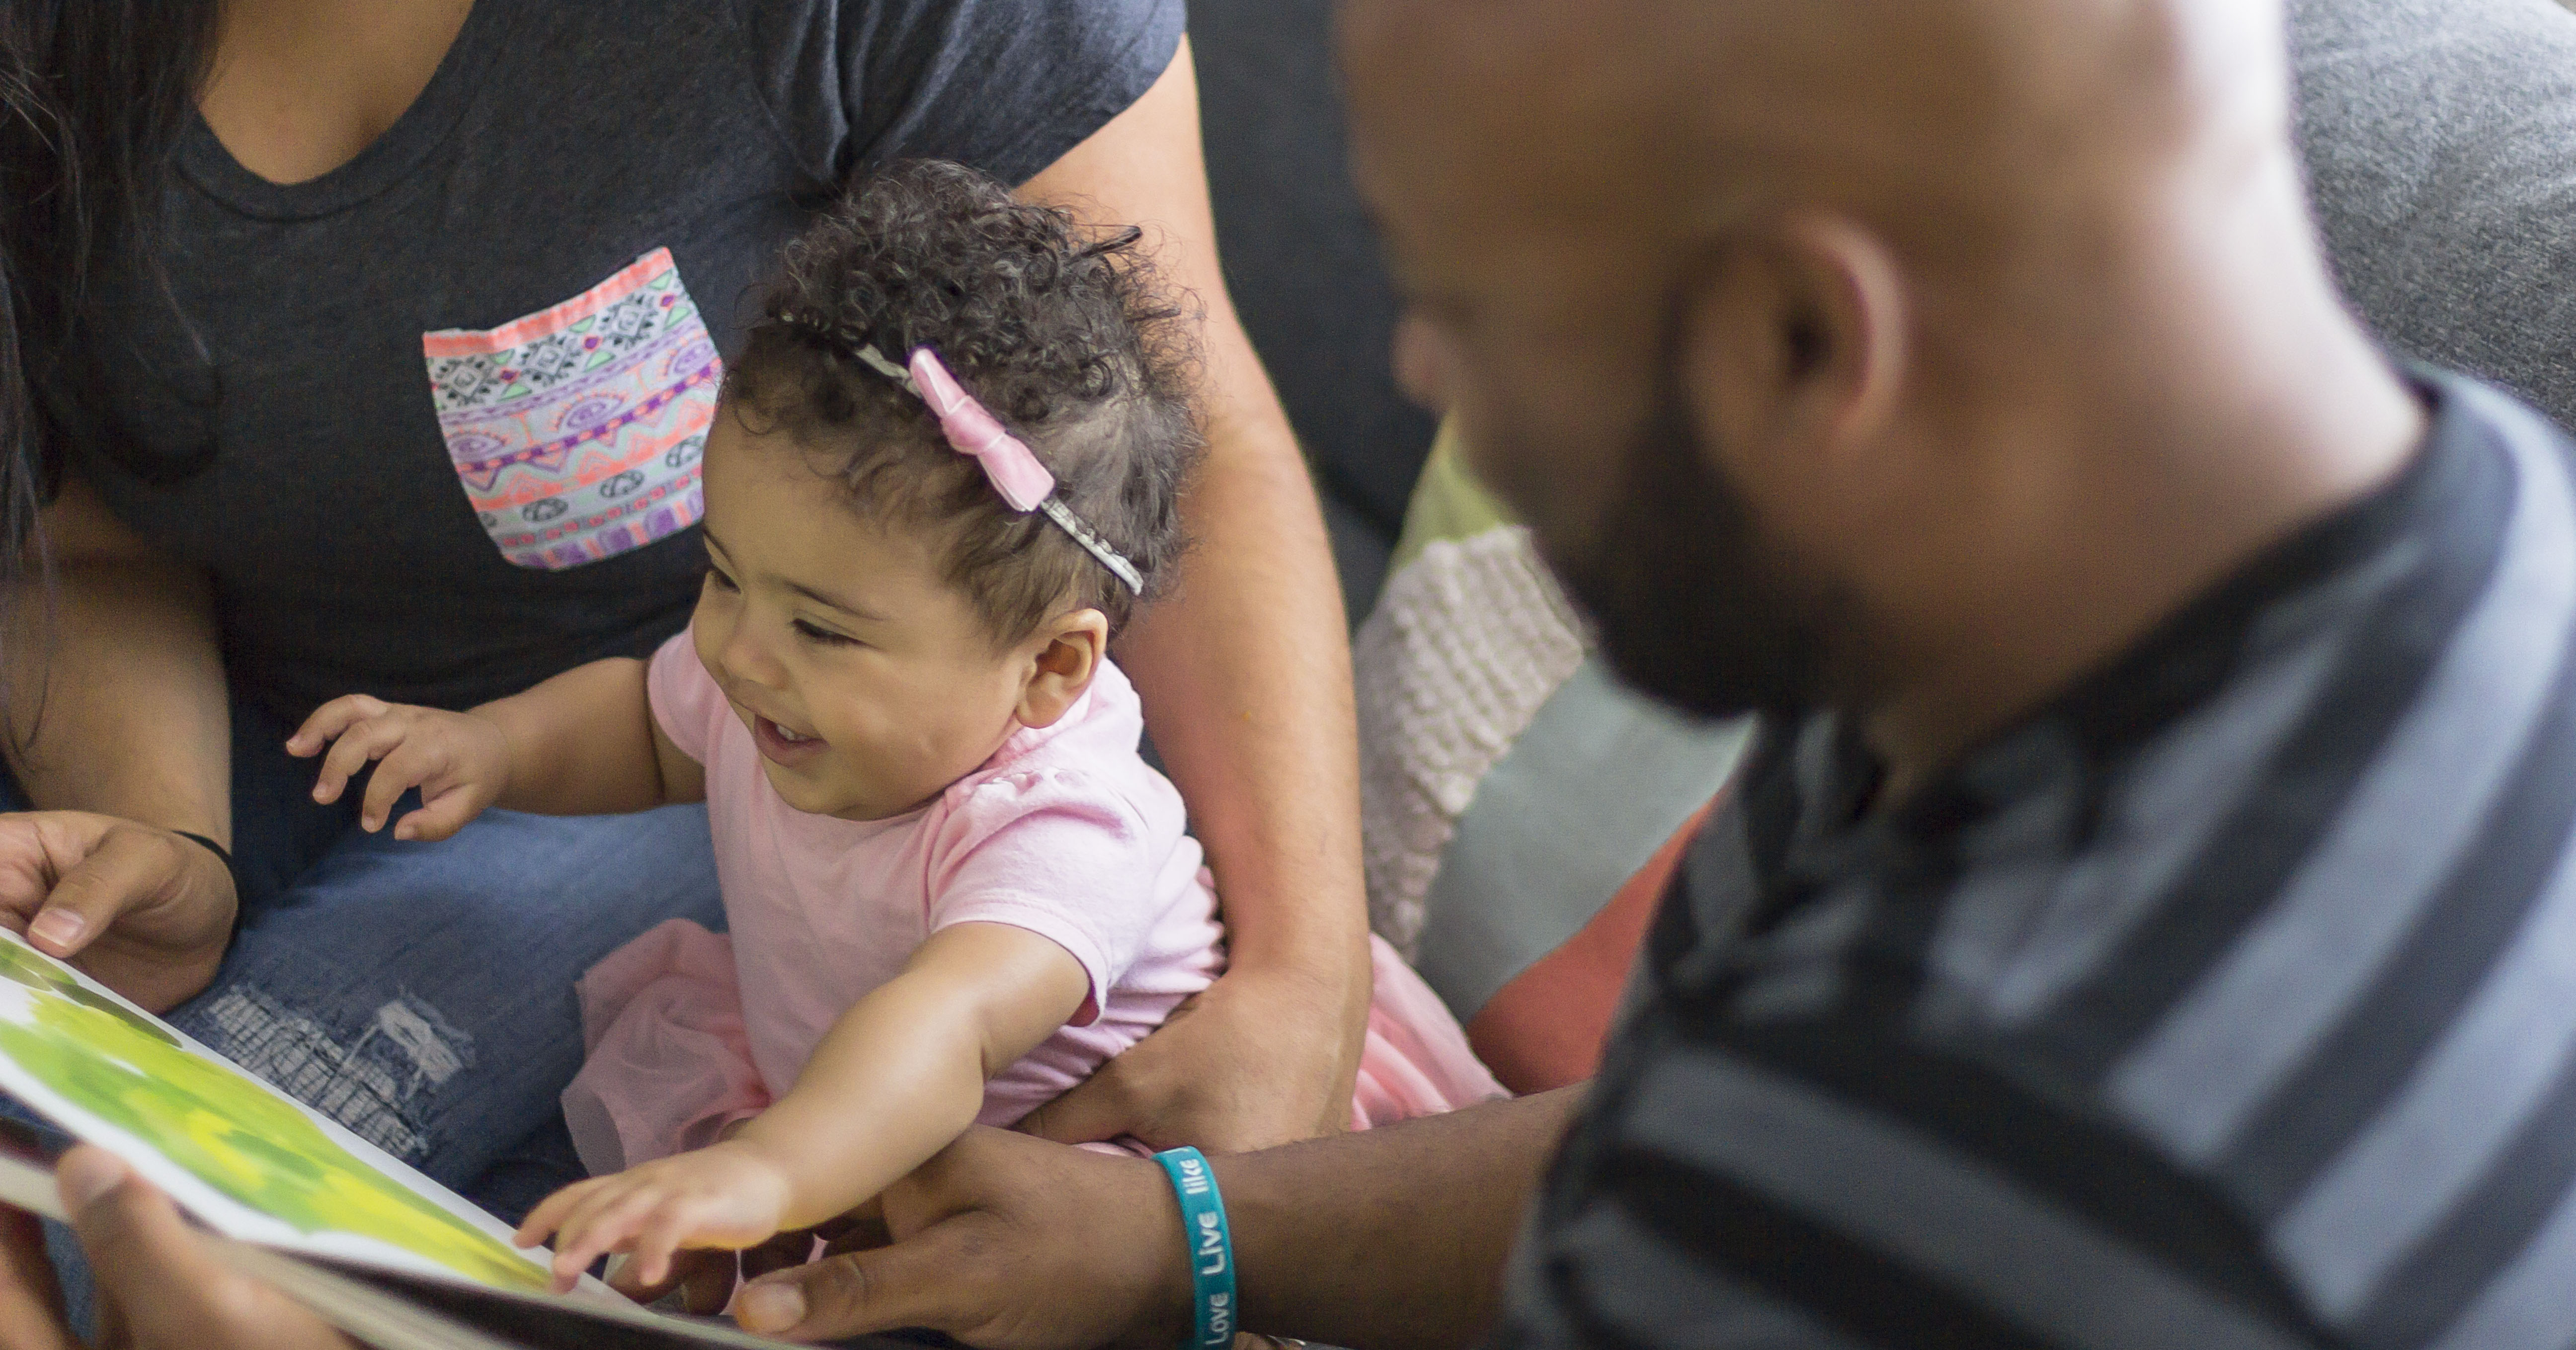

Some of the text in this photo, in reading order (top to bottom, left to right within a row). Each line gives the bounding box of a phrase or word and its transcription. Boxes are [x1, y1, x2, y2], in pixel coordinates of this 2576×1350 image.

[1180, 1159, 1229, 1345] Love Live like
